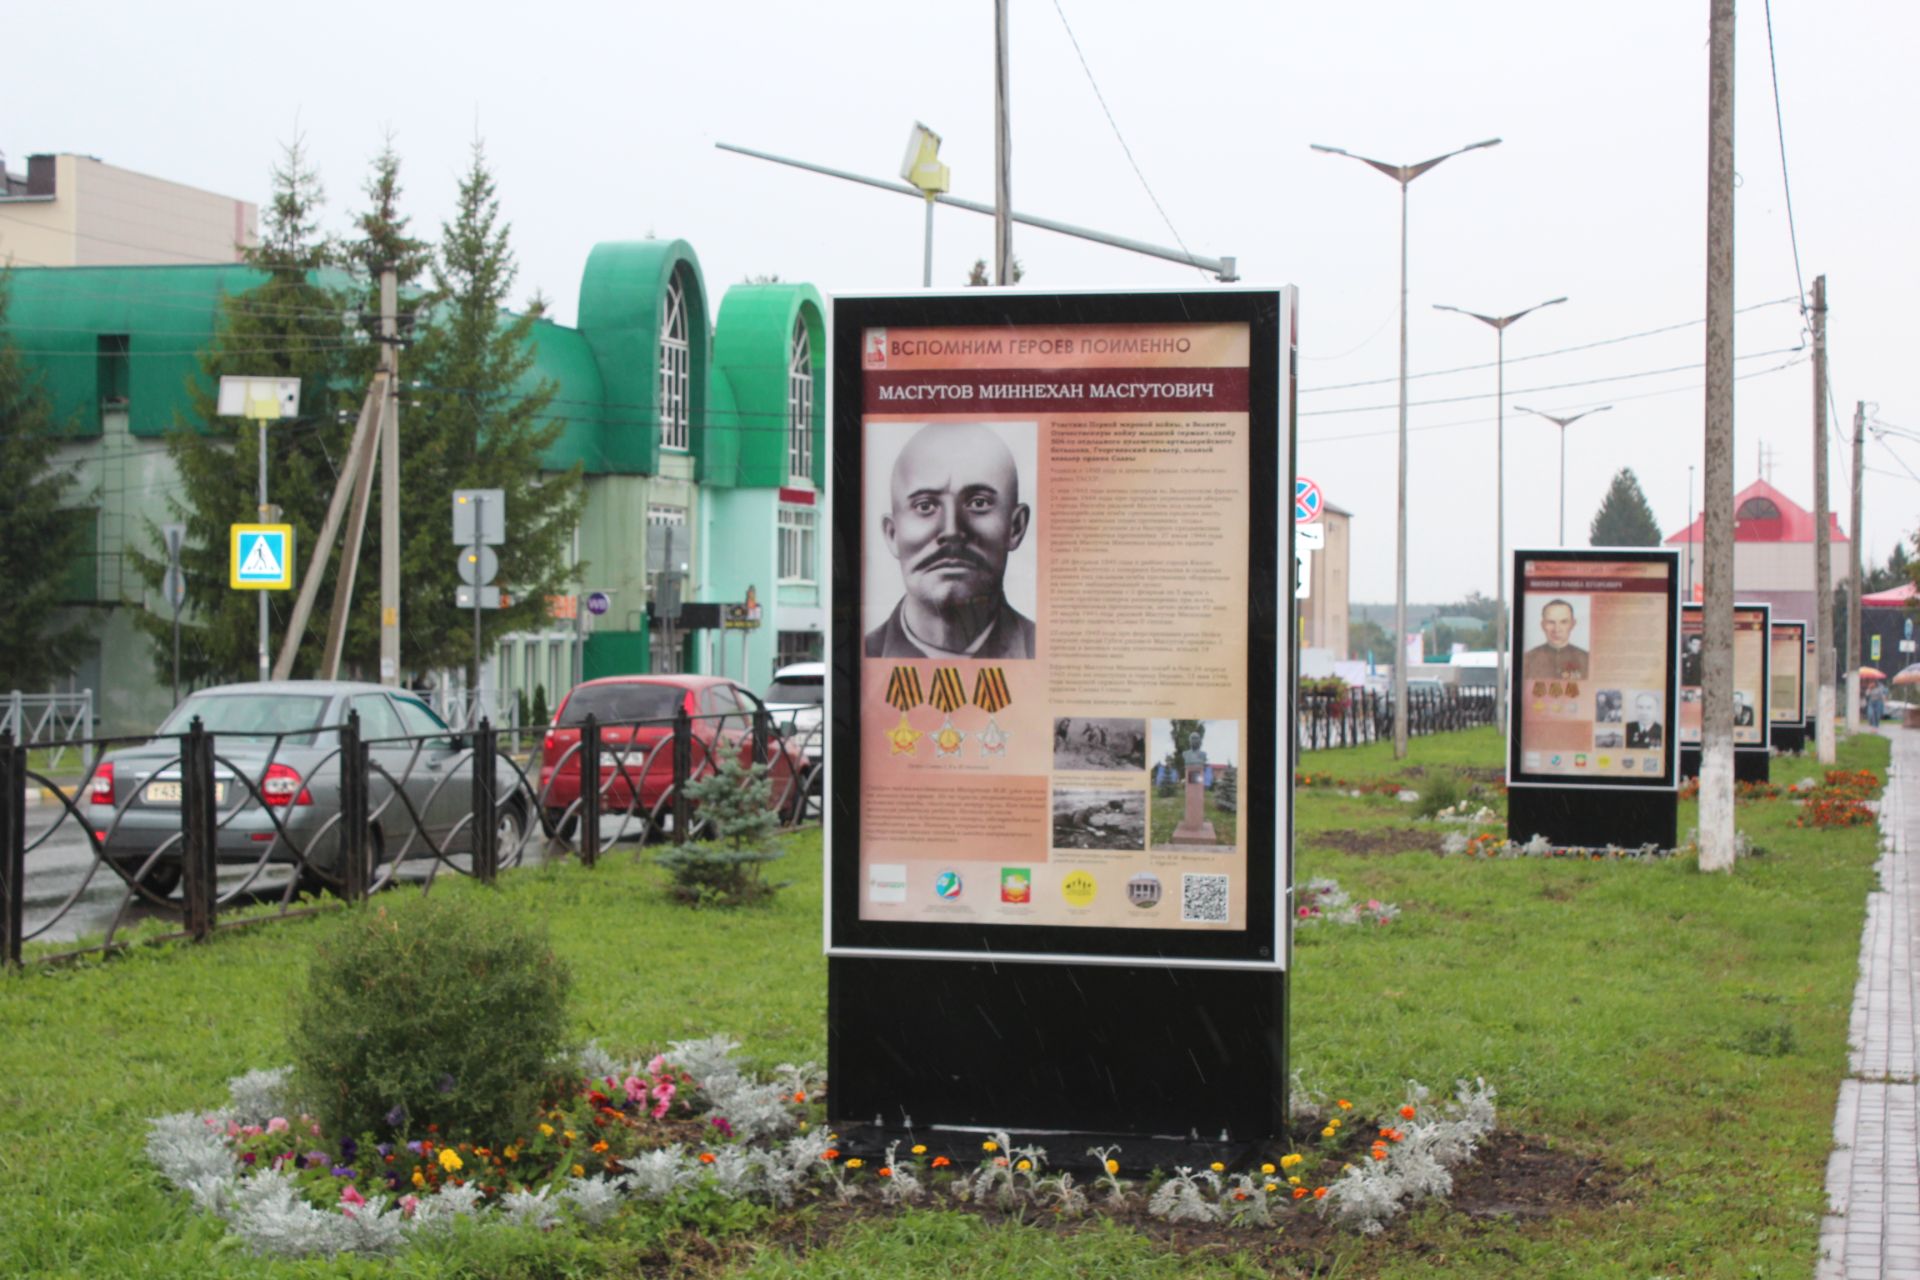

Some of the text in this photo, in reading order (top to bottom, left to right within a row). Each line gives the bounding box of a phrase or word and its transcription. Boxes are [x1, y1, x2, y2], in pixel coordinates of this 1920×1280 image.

[890, 337, 1191, 356] ВСПОМНИМ ГЕРОЕВ ПОИМЕННО
[878, 382, 1214, 400] МАСГУТОВ МИННЕХАН МАСГУТОВИЧ
